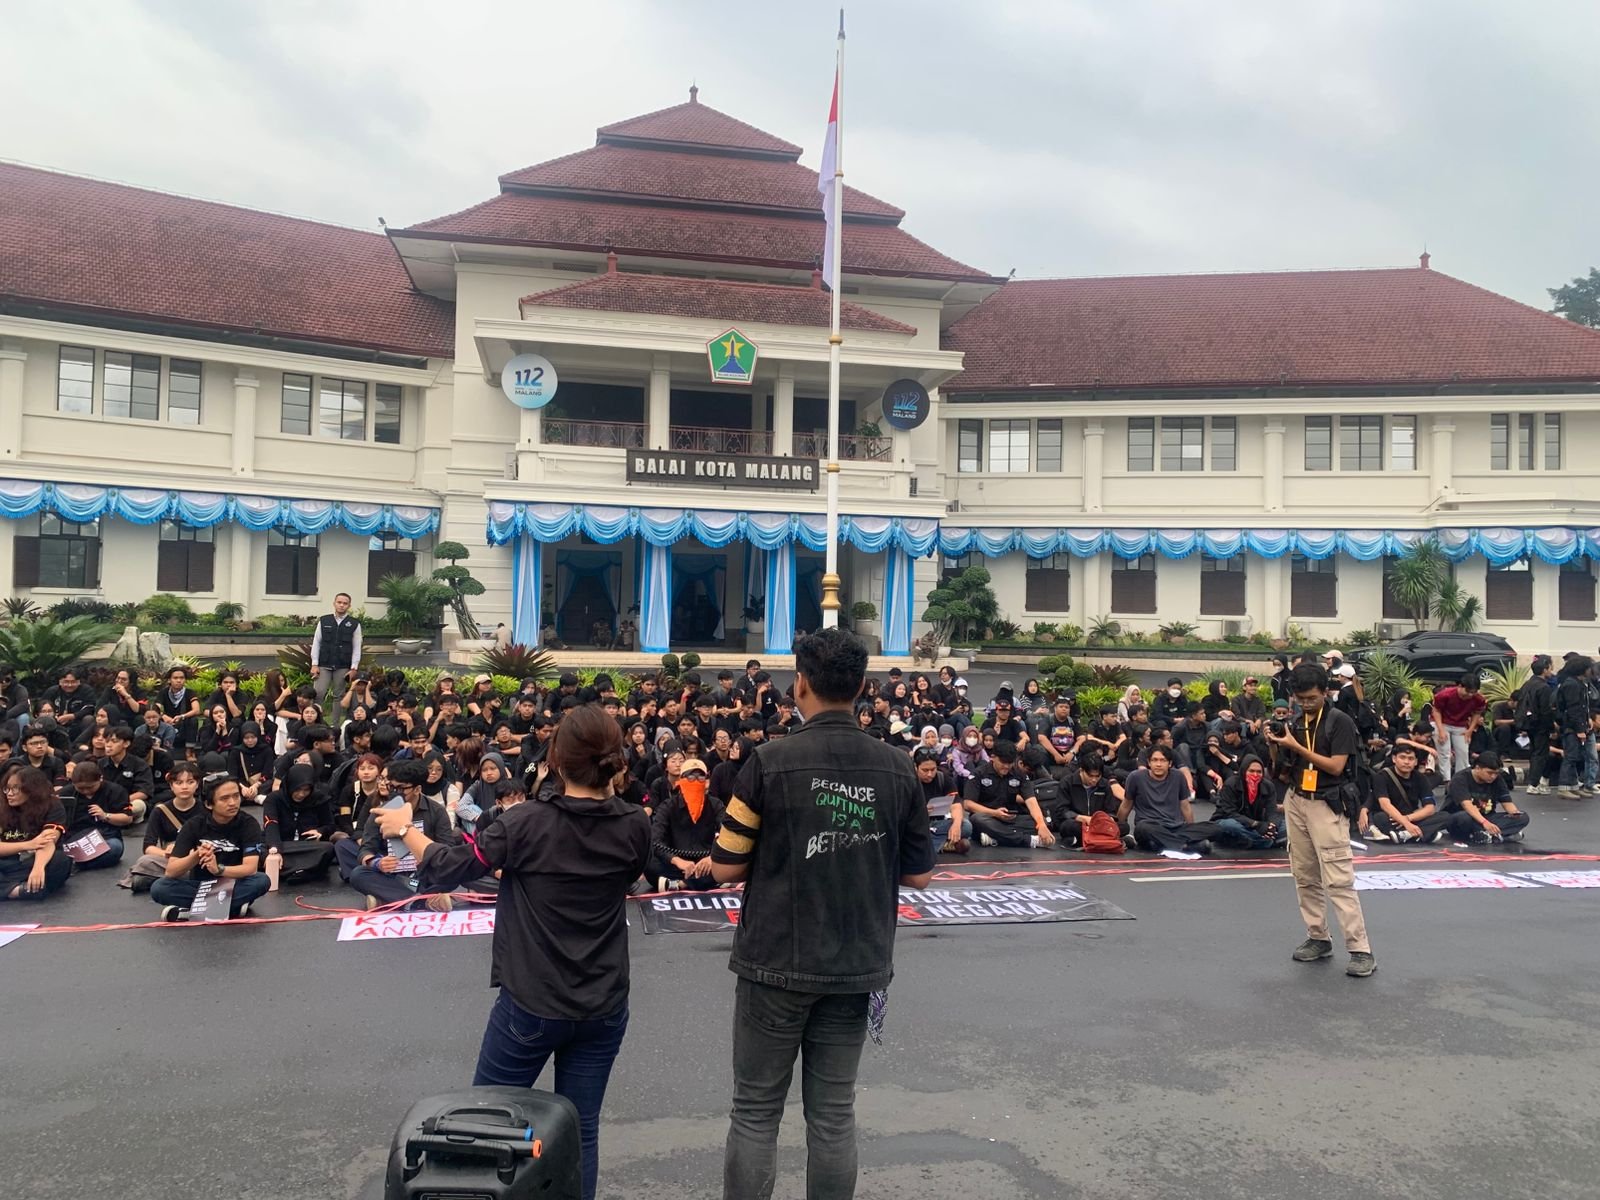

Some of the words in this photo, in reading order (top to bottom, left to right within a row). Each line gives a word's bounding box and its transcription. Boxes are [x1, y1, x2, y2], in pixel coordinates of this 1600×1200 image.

[515, 367, 544, 386] 112
[635, 458, 686, 475] BALAI
[695, 461, 736, 477] KOTA
[745, 463, 813, 481] MALANG
[811, 777, 876, 802] BECAUSE
[815, 792, 875, 820] QUITING
[831, 811, 847, 827] IS
[849, 819, 862, 830] A
[652, 897, 742, 911] SOLID
[898, 892, 963, 904] TUK
[925, 902, 1056, 918] NEGARA
[355, 912, 448, 926] KAMI
